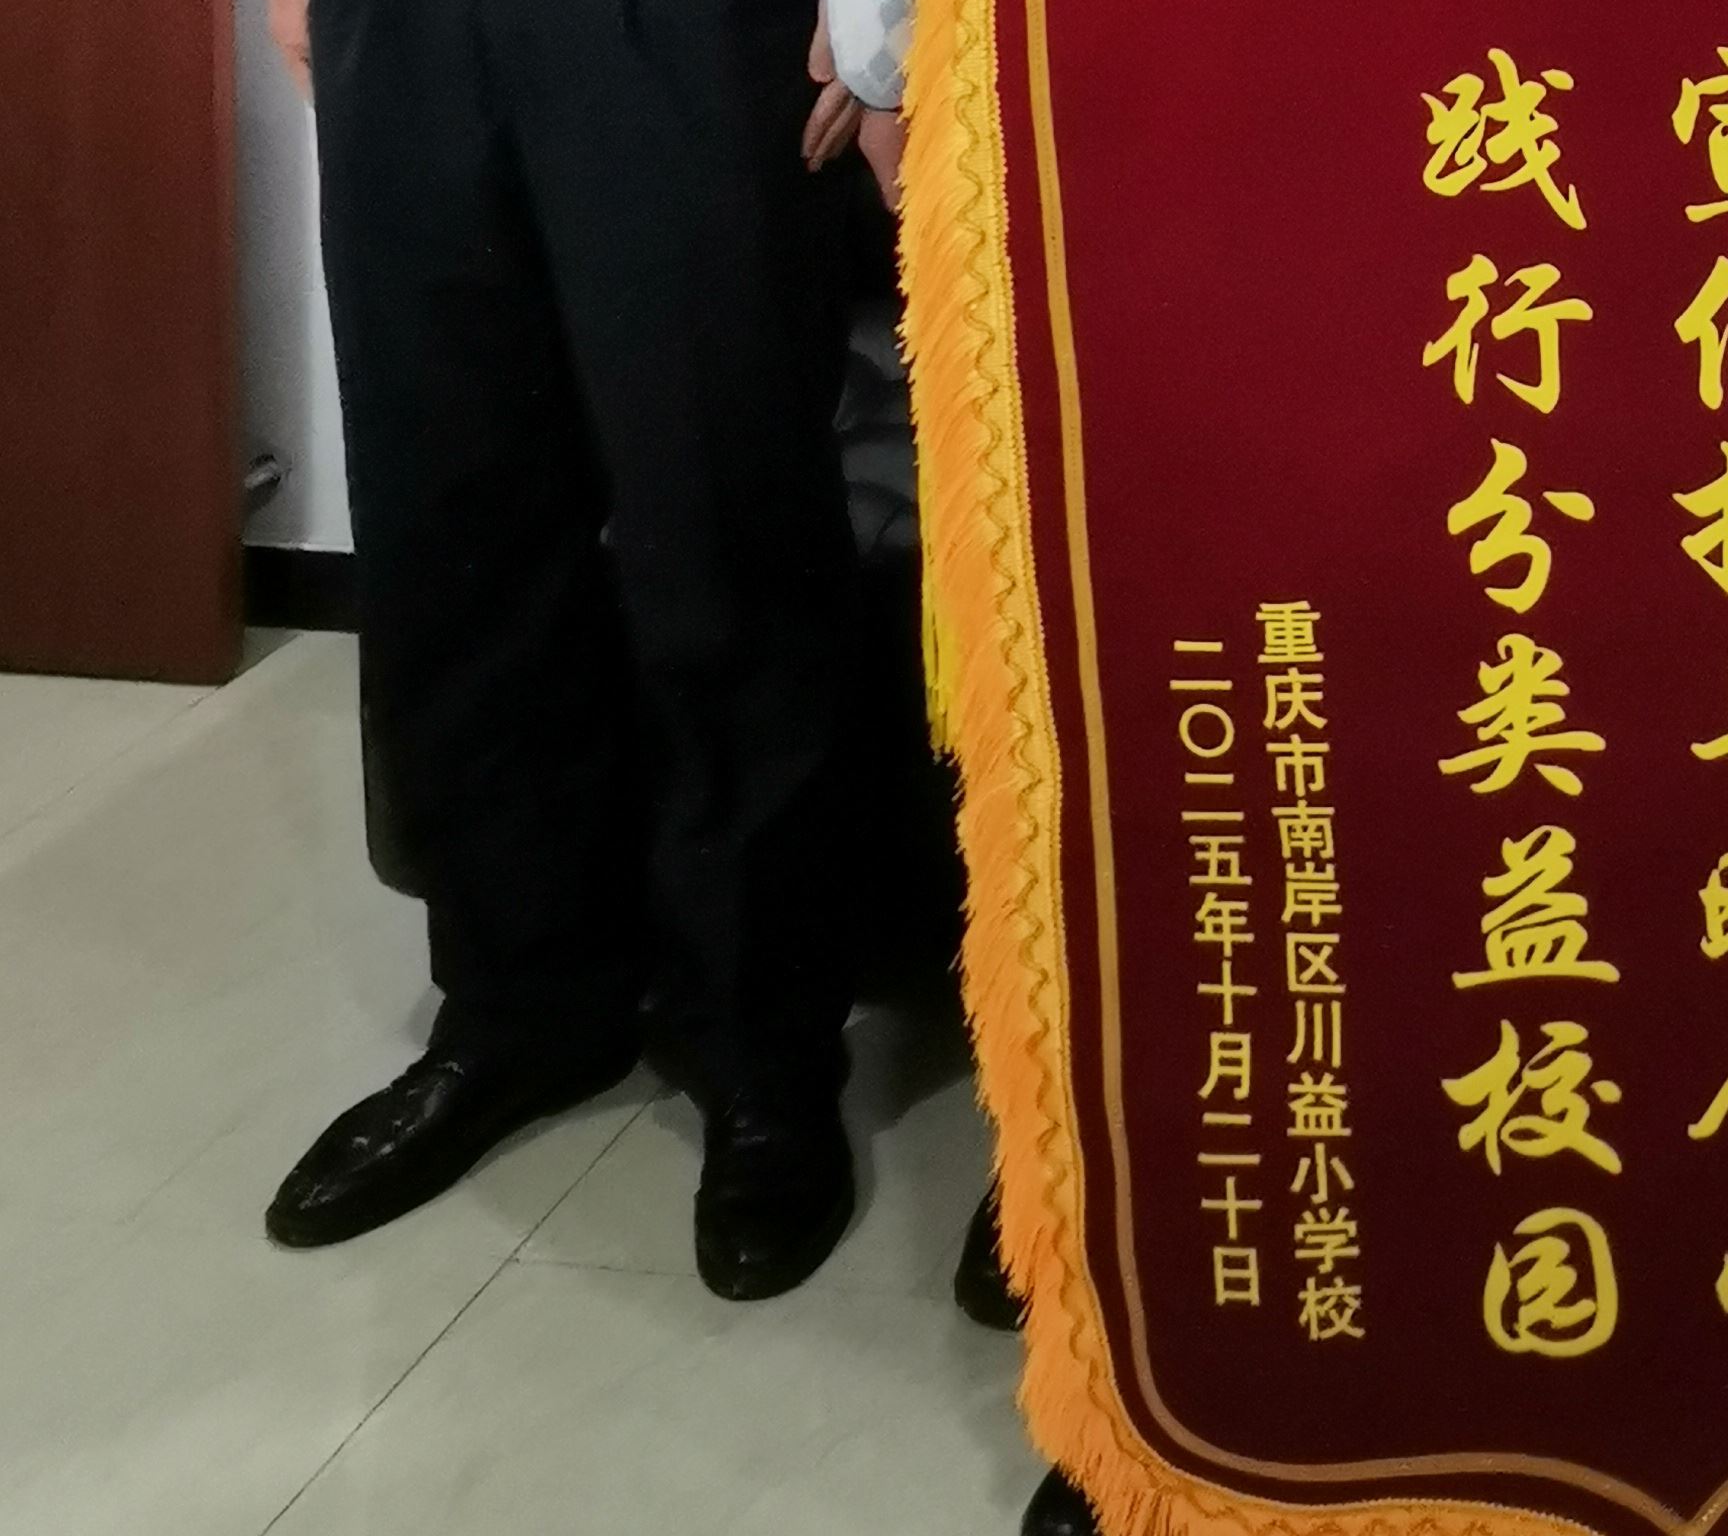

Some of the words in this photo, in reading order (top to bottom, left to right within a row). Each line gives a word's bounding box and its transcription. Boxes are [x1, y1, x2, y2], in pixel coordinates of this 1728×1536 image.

[1255, 600, 1367, 1341] 重庆市南岸区川益小学校
[1421, 47, 1623, 1358] 践行分类益校园
